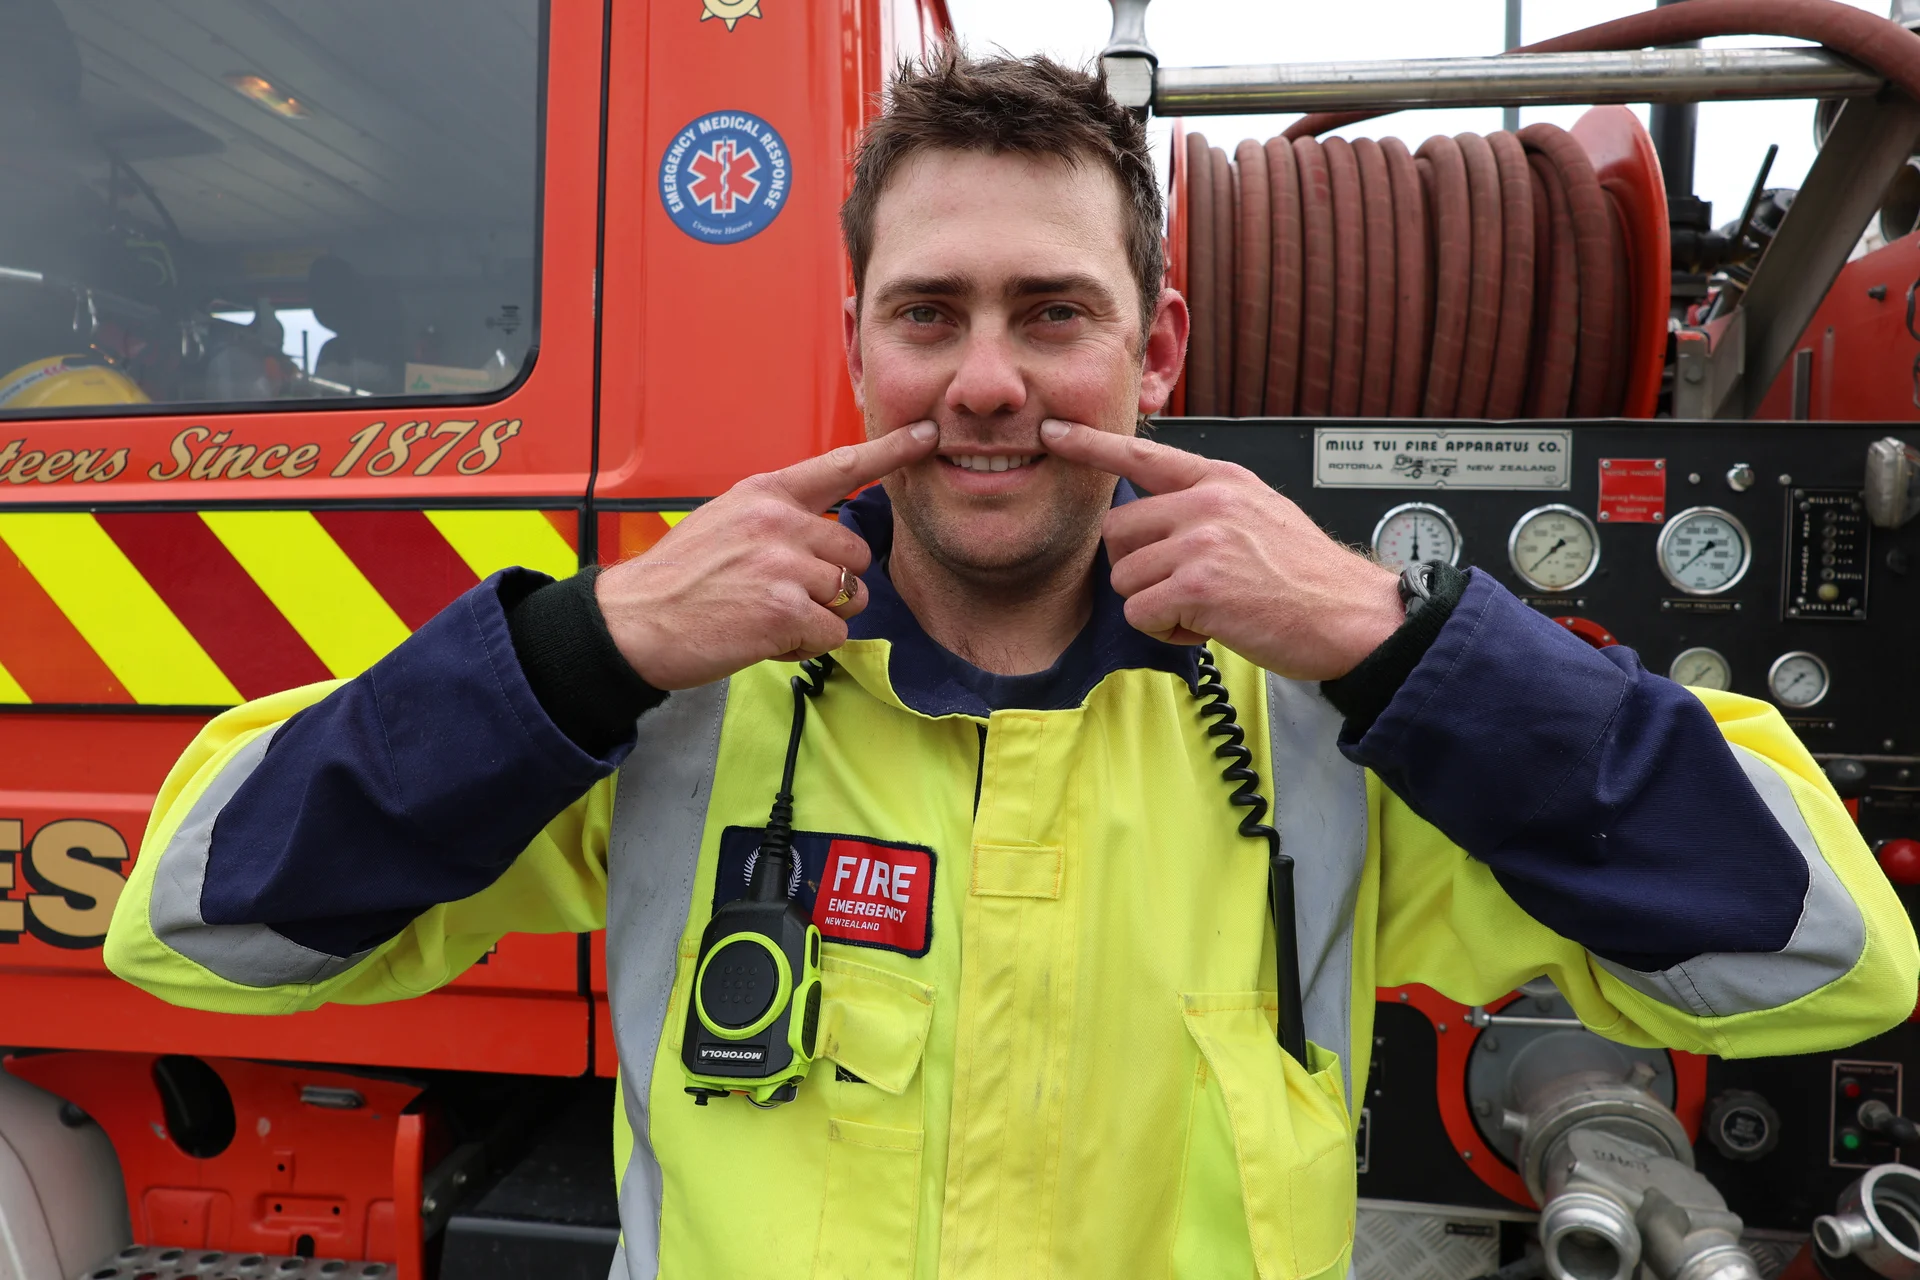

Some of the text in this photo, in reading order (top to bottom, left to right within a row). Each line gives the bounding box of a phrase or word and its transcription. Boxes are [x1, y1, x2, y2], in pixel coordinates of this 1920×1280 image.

[664, 115, 786, 214] EMERGENCY MEDICAL RESPONSE
[148, 425, 320, 481] Since
[329, 418, 523, 478] 1878
[1325, 440, 1562, 453] MILLS TUI FIRE APPARATUS CO.
[1466, 464, 1494, 472] NEW
[1499, 464, 1557, 473] ZEALAND
[0, 817, 131, 949] S
[832, 855, 917, 903] FIRE
[828, 898, 907, 923] EMERGENCY
[701, 1049, 762, 1060] MOTOROLA
